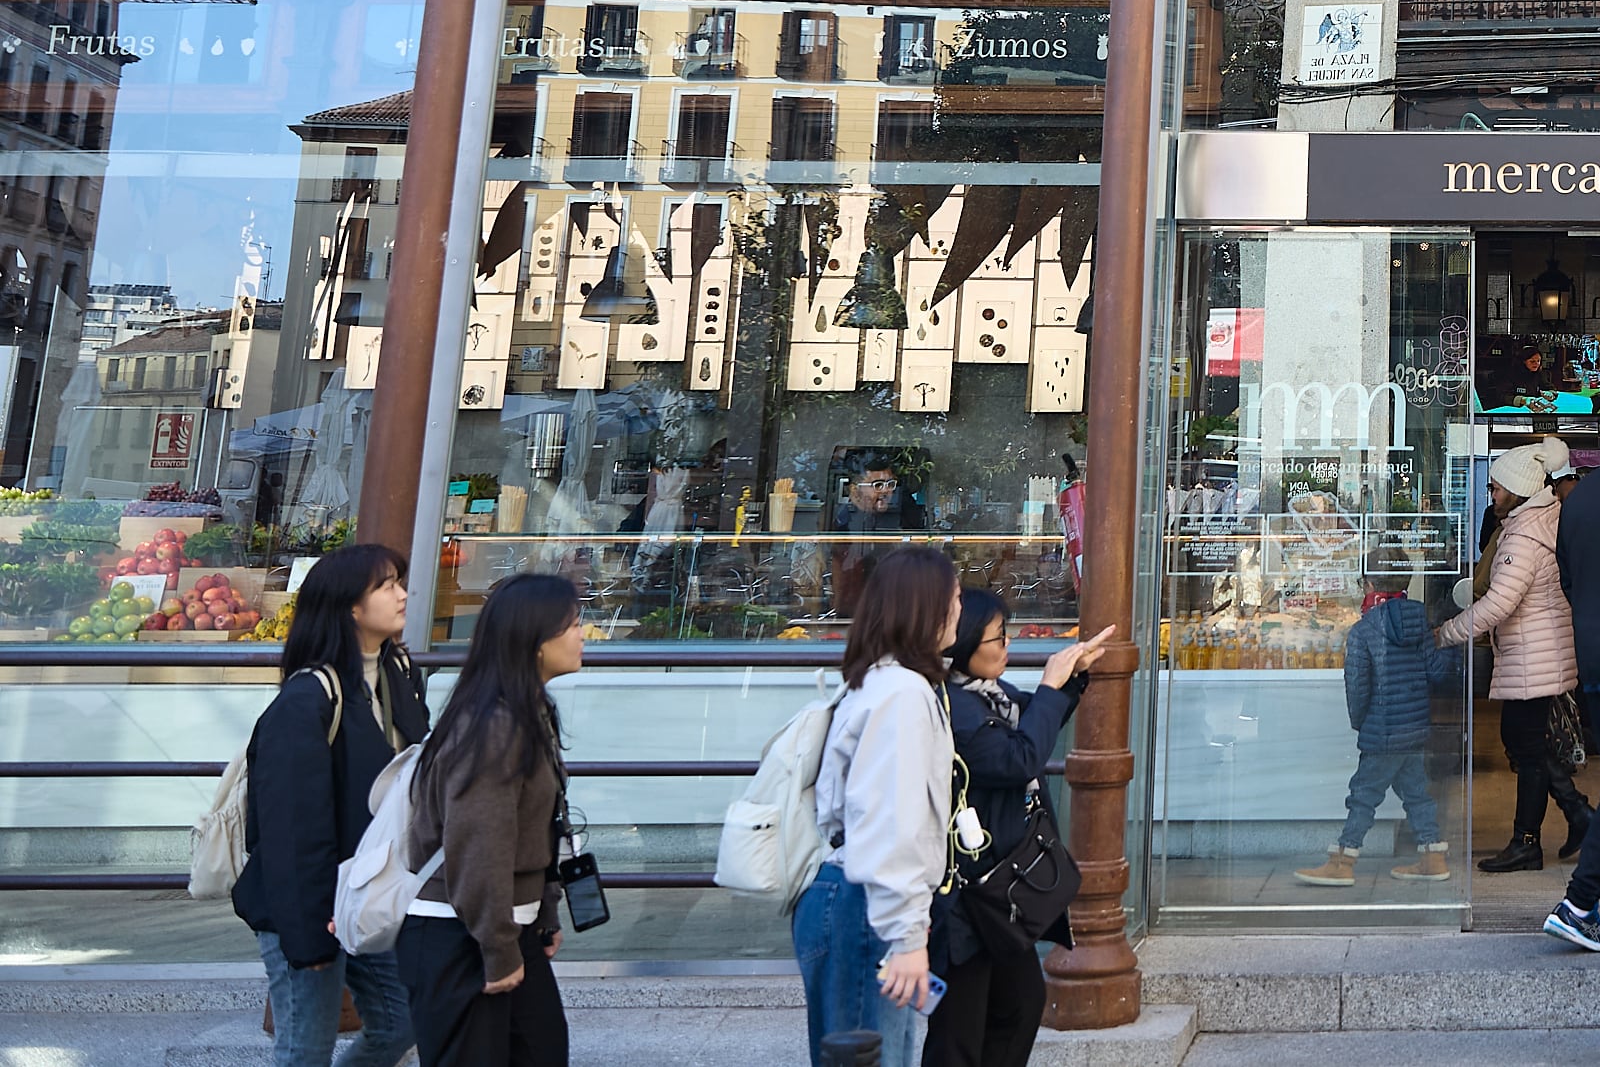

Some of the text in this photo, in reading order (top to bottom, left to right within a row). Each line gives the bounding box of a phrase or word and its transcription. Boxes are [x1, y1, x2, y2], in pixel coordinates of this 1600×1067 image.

[45, 24, 156, 57] Frutas
[501, 27, 605, 58] Frutas
[956, 28, 1068, 59] Zumos
[1534, 421, 1556, 432] SALIDA
[152, 460, 187, 468] EXTINTOR
[1238, 458, 1304, 474] mercado
[1363, 458, 1414, 480] miguel
